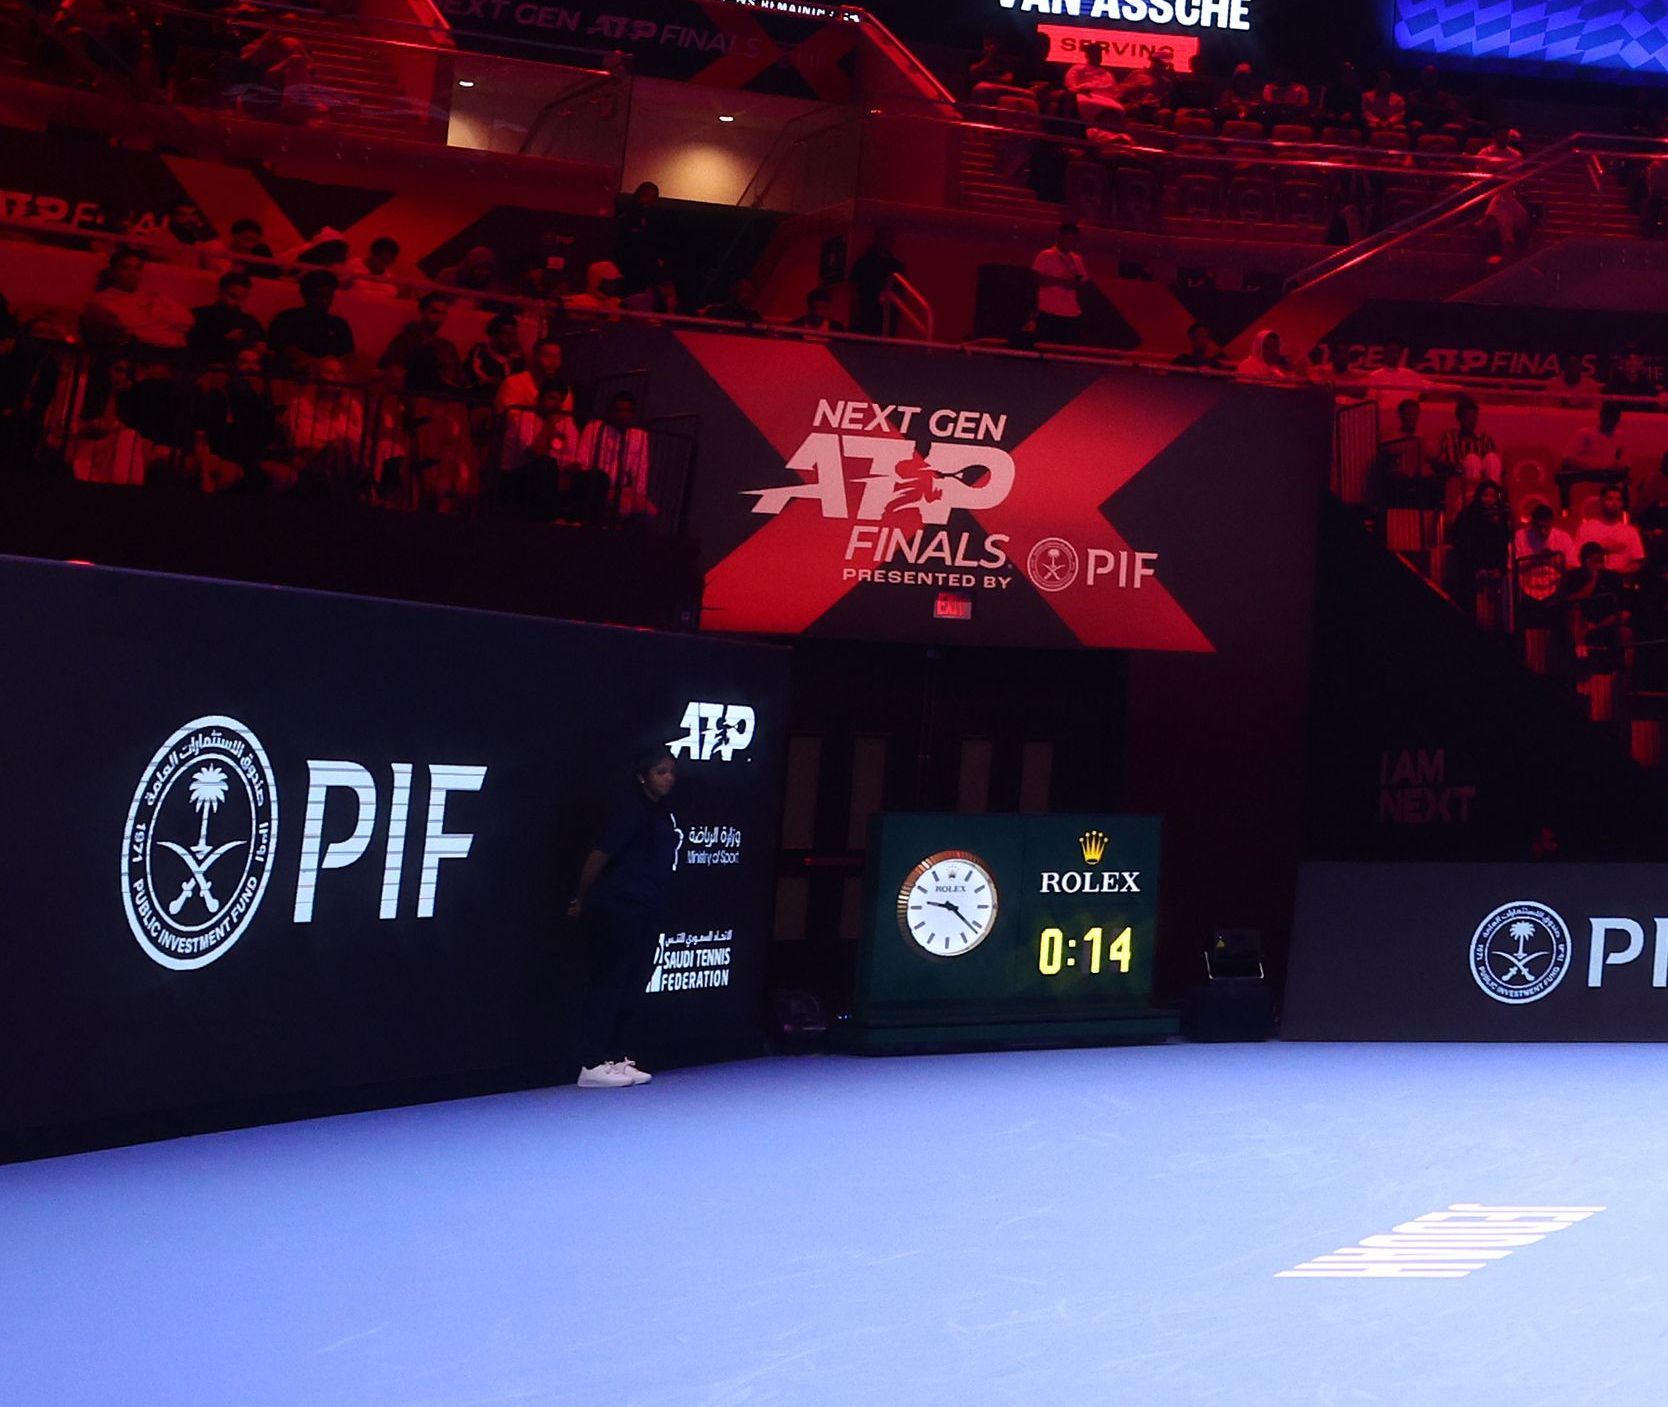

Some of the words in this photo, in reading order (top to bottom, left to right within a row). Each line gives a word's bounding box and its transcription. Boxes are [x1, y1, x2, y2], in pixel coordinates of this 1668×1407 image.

[513, 3, 582, 33] GEN
[1489, 349, 1598, 377] FINAS
[812, 399, 921, 434] NEXT
[928, 408, 1007, 441] GEN
[738, 432, 1015, 525] ATP
[844, 525, 1010, 569] FINALS
[843, 568, 976, 587] PRESENTED
[983, 575, 1012, 590] BY
[1086, 548, 1158, 588] PIF
[665, 702, 756, 762] ATP
[292, 760, 488, 923] PIF
[1040, 871, 1140, 893] ROLEX
[132, 877, 161, 938] PUBLIC
[157, 918, 231, 953] INVESTMENT
[229, 876, 258, 923] FUND
[663, 950, 694, 969] SAUDI
[696, 947, 731, 967] TENNIS
[1039, 926, 1132, 975] 0:14
[661, 969, 729, 991] FEDERATION
